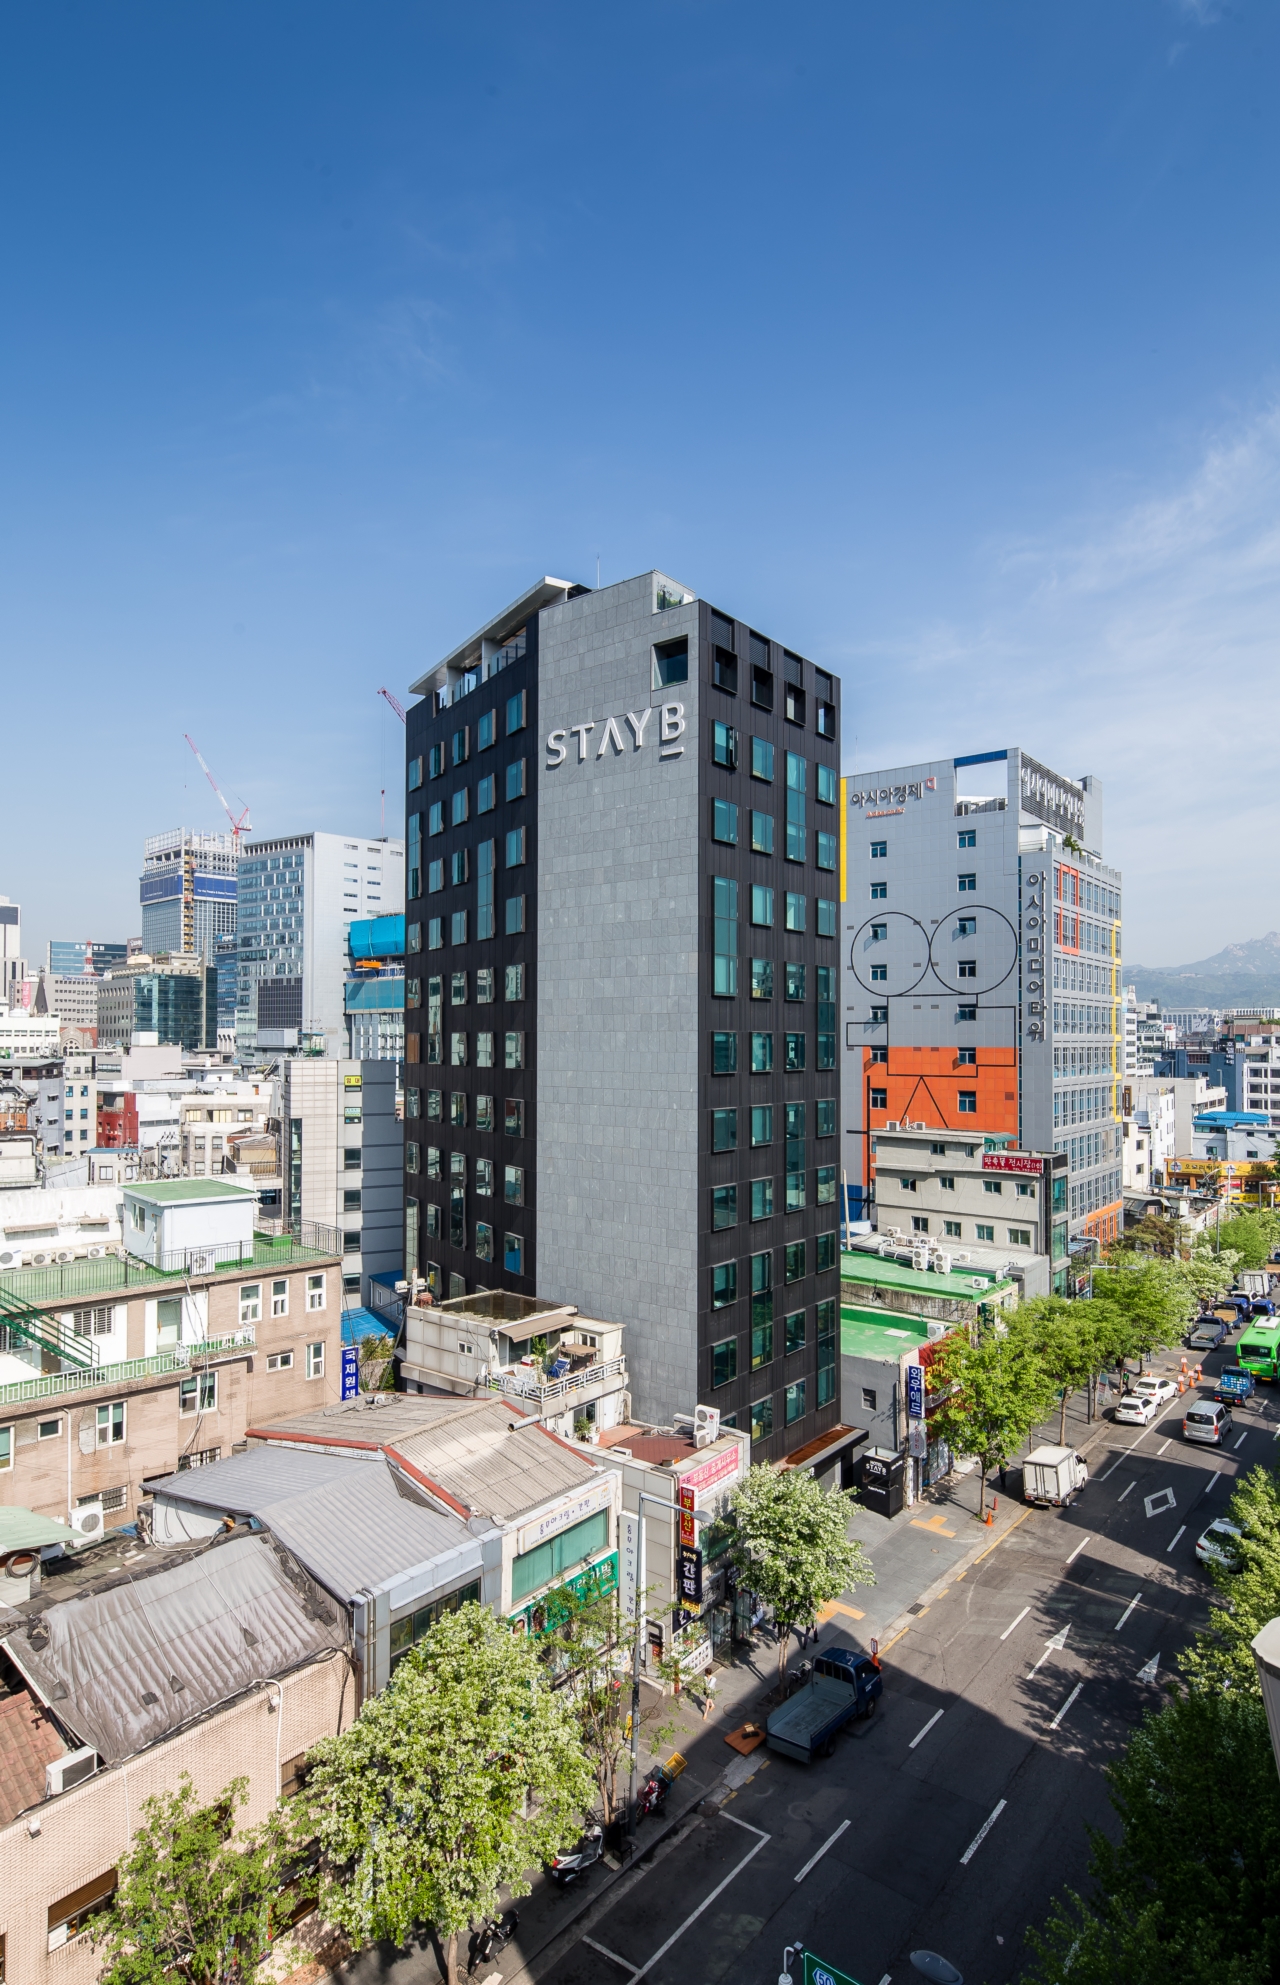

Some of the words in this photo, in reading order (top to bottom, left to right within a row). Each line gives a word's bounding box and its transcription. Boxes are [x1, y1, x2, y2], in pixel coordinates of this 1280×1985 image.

[852, 782, 923, 807] 아시아경제
[1028, 870, 1048, 1041] 아시아미디어타워
[910, 1368, 921, 1413] 와우애드
[683, 1562, 696, 1596] 간판
